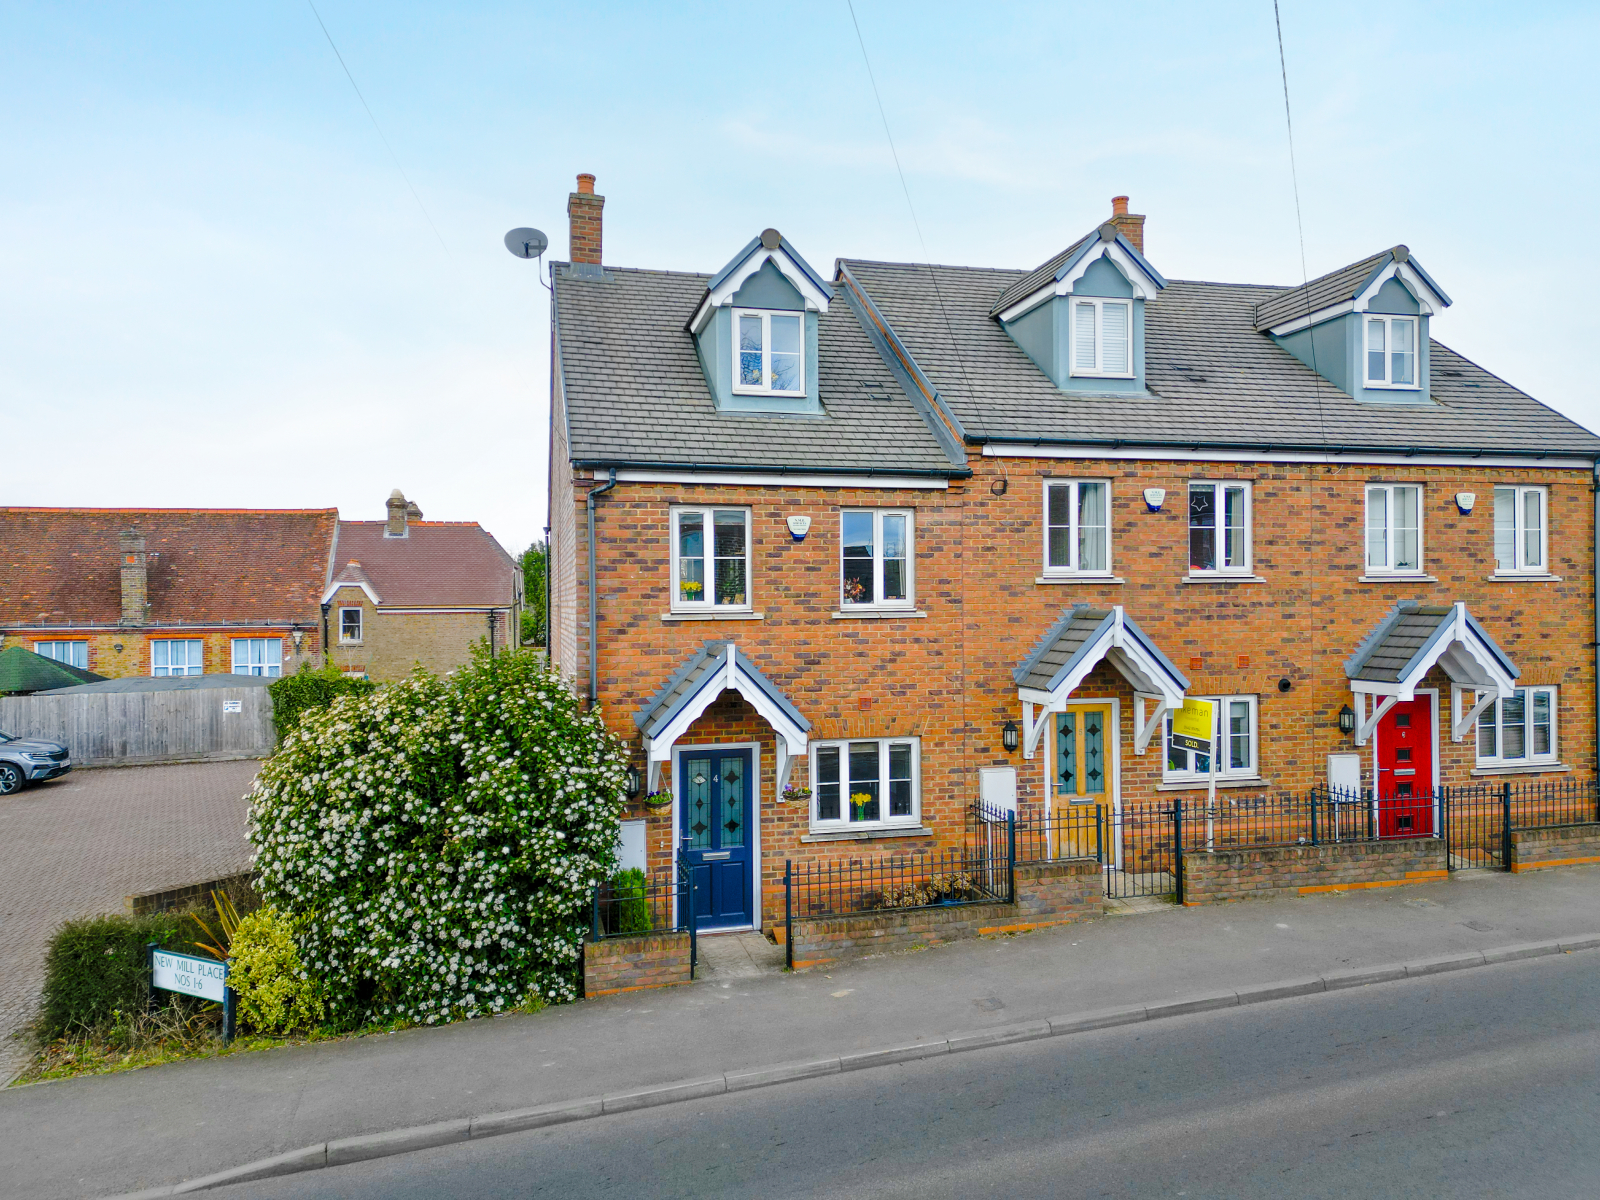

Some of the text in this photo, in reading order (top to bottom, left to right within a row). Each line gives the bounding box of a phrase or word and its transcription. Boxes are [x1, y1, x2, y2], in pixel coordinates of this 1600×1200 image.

[713, 774, 718, 783] 4
[154, 955, 224, 980] NEW MILL PLACE
[174, 973, 190, 987] NOS
